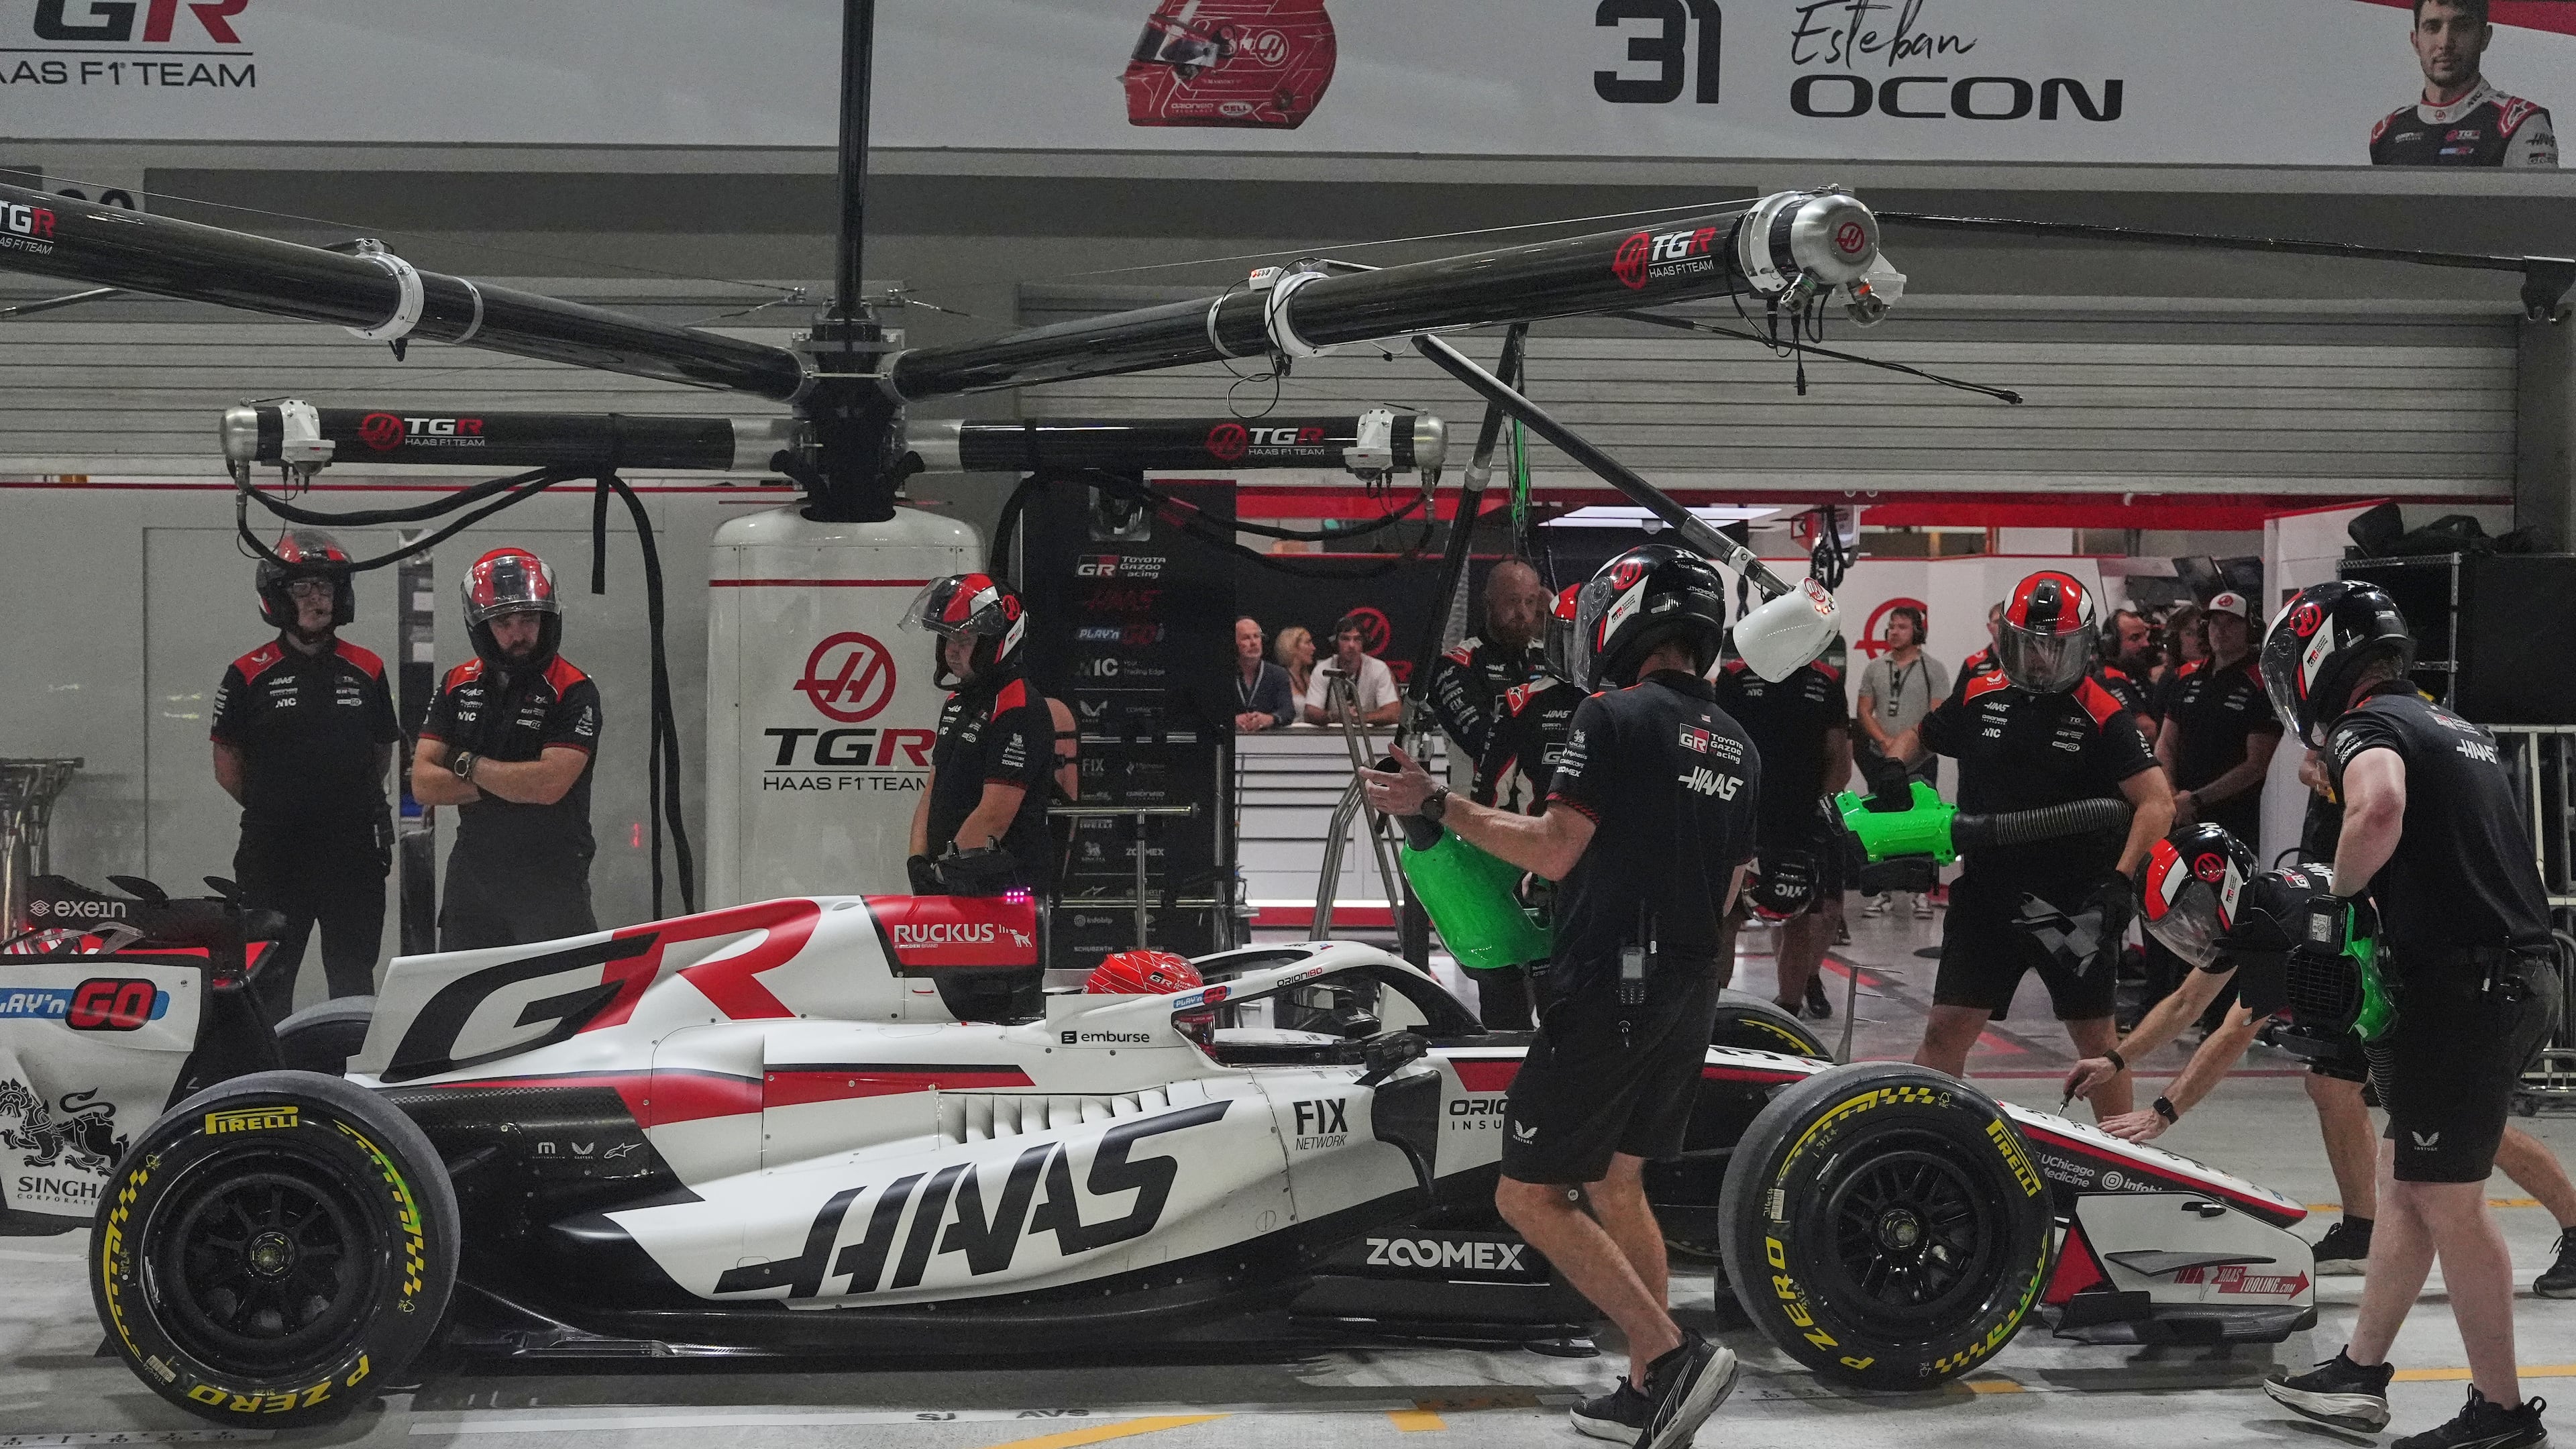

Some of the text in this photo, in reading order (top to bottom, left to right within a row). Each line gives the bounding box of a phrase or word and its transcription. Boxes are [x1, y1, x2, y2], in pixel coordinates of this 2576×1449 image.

[1790, 0, 1978, 70] Esteban
[1593, 0, 1722, 104] 31
[0, 60, 67, 85] AS
[132, 62, 256, 87] TEAM
[1790, 74, 2123, 122] OCON
[12, 239, 23, 249] F1
[25, 241, 53, 256] TEAM
[1650, 227, 1716, 261] TGR
[1649, 260, 1714, 278] HAAS F1 TEAM
[404, 417, 484, 436] TGR
[405, 438, 485, 447] HAAS F1 TEAM
[1249, 427, 1325, 445] TGR
[1248, 447, 1325, 456] HAAS F1 TEAM
[1122, 555, 1166, 564] TOYOTA
[1078, 564, 1116, 576] GR
[1127, 570, 1159, 579] acing
[1542, 710, 1571, 718] HAAS
[1984, 701, 2010, 712] HAAS
[764, 729, 936, 767] TGR
[1680, 733, 1707, 752] GR
[1710, 741, 1742, 756] GAZOO
[1711, 733, 1743, 751] TOYOTA
[1544, 751, 1562, 763] G
[1566, 749, 1588, 760] Mphasis
[1710, 749, 1741, 764] Racing
[2456, 739, 2498, 764] HAAS
[1001, 759, 1024, 768] ZOOMEX
[763, 777, 832, 791] HAAS
[1678, 765, 1744, 801] HAAS
[1126, 848, 1165, 856] ZOMEX
[894, 924, 995, 943] RUCKUS
[1149, 974, 1173, 988] GR
[380, 899, 821, 1083] GR
[68, 982, 152, 1027] GO
[1176, 995, 1202, 1007] PLAY'n
[1081, 1030, 1150, 1043] emburse
[205, 1106, 299, 1134] PIRELLI
[1293, 1098, 1348, 1136] FIX
[1295, 1134, 1347, 1150] NETWORK
[1986, 1118, 2042, 1197] PIRELLI
[2041, 1154, 2095, 1177] UChicago
[17, 1193, 94, 1206] CORPORATI
[713, 1099, 1233, 1298] HAAS
[1366, 1238, 1524, 1271] ZOOMEX
[2217, 1268, 2243, 1283] HAAS
[1765, 1236, 1838, 1351] ZERO
[2239, 1277, 2296, 1293] TOOLING.COM
[347, 1355, 369, 1387] P
[1840, 1356, 1875, 1369] P
[187, 1381, 331, 1413] ZERO
